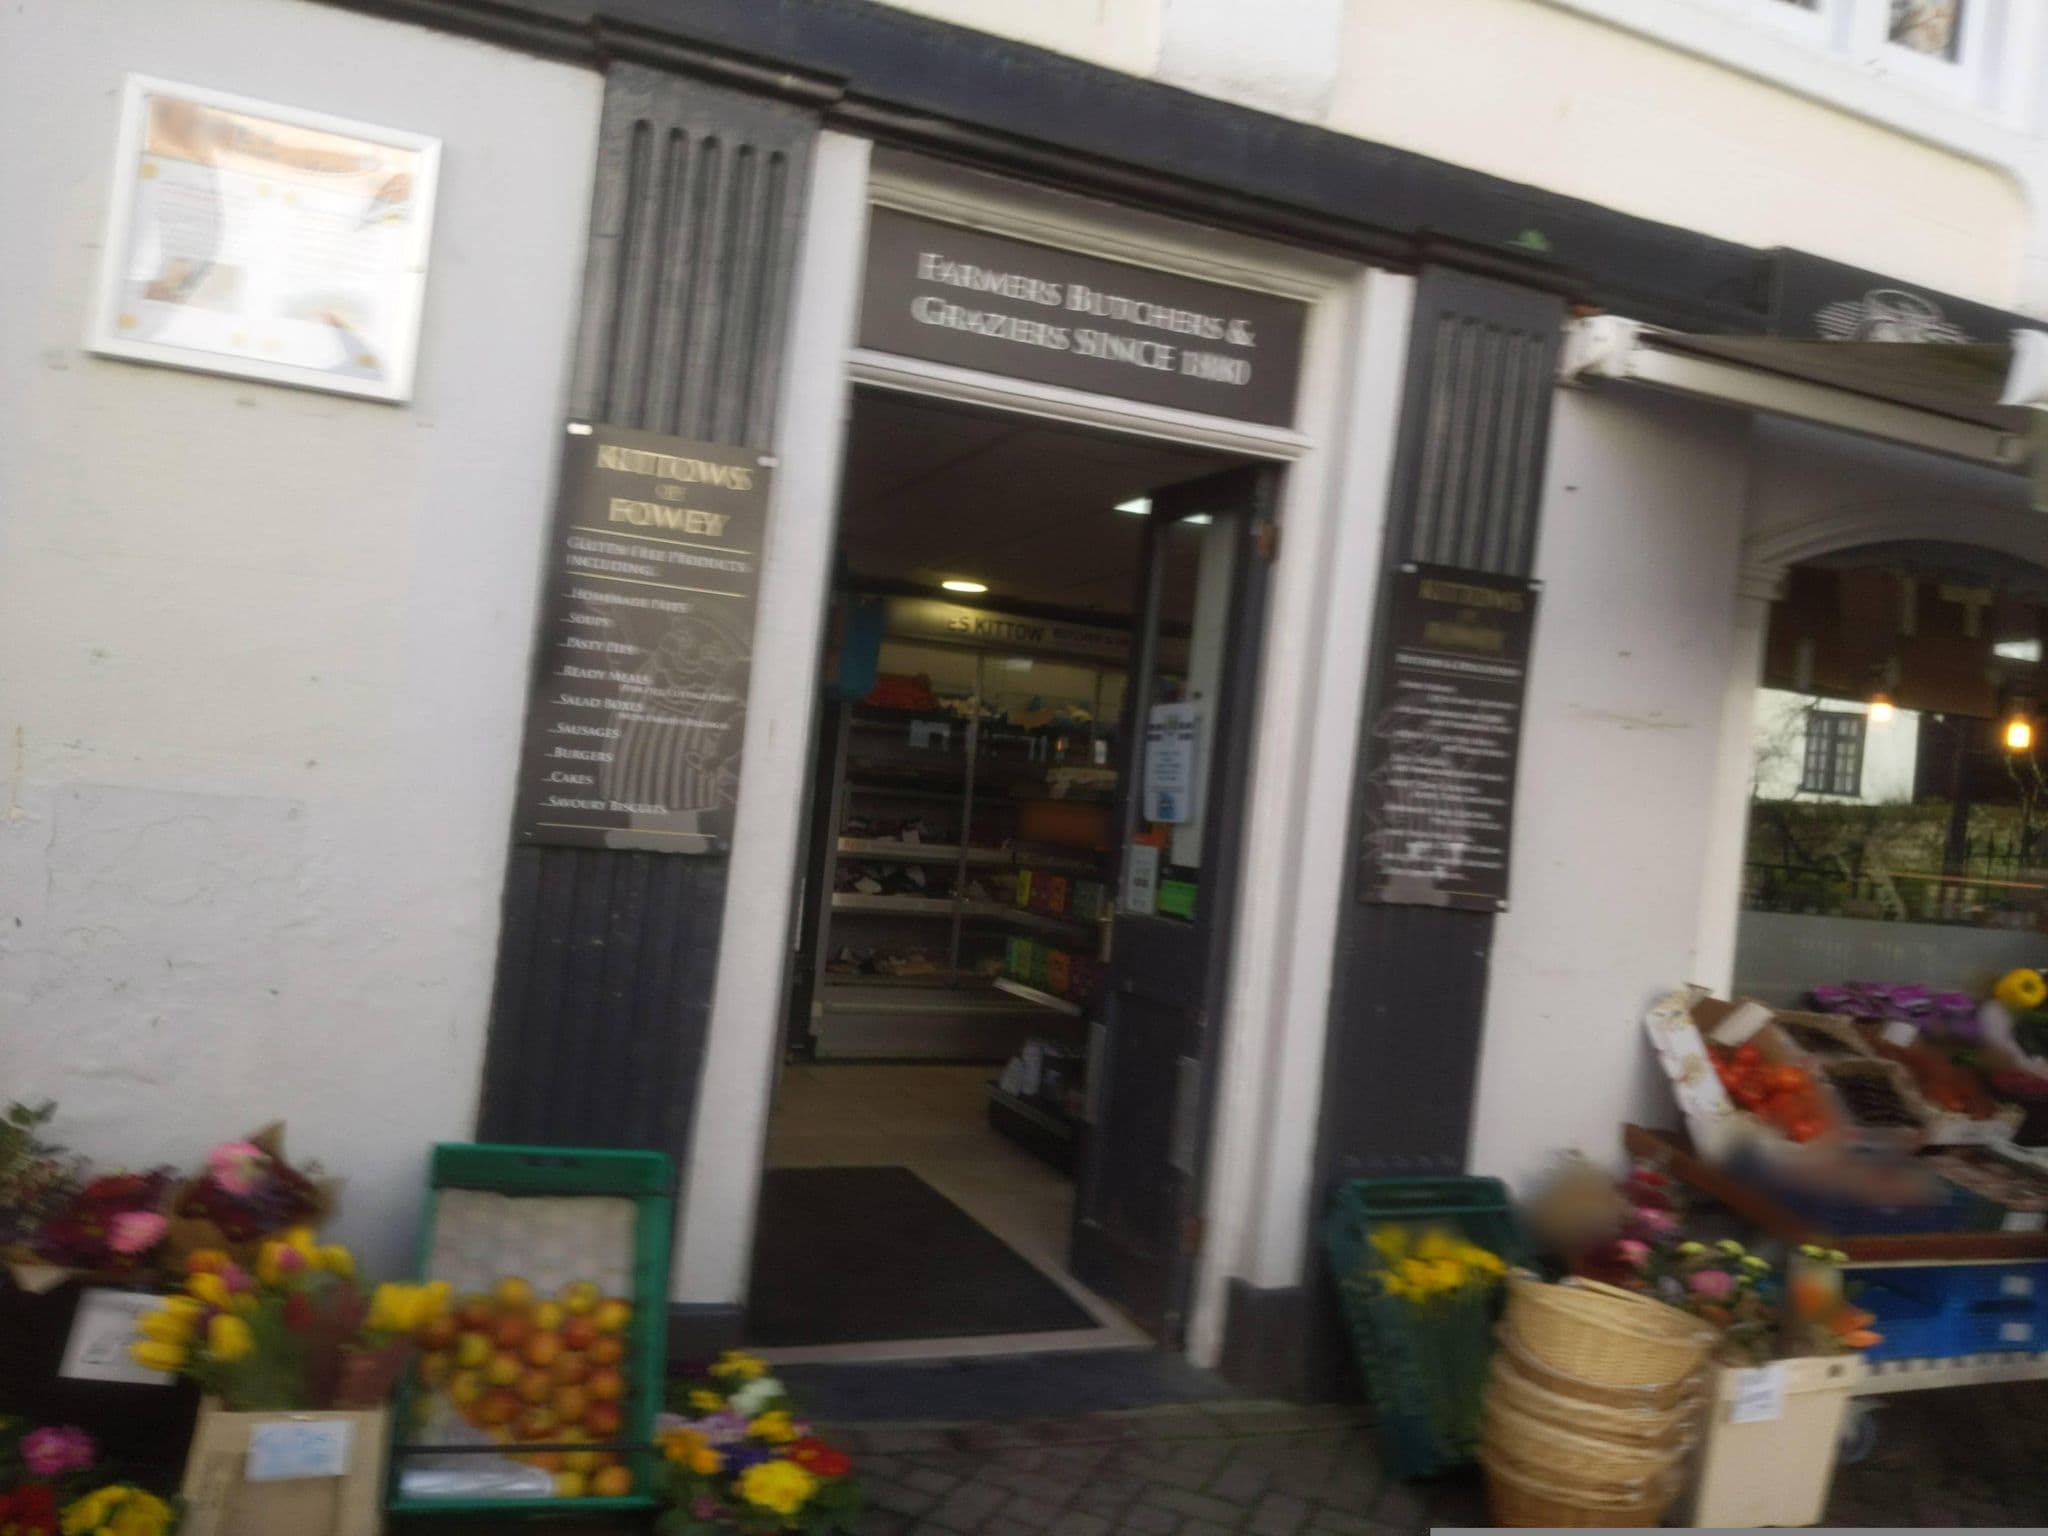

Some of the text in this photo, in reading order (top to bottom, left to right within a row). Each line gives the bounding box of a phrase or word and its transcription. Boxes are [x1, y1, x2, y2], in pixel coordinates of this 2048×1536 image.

[910, 296, 1071, 350] GRAZIERS
[1072, 328, 1176, 371] SINCE
[918, 252, 1256, 346] FARMERS BUTCHERS &
[608, 497, 731, 537] FOWEY
